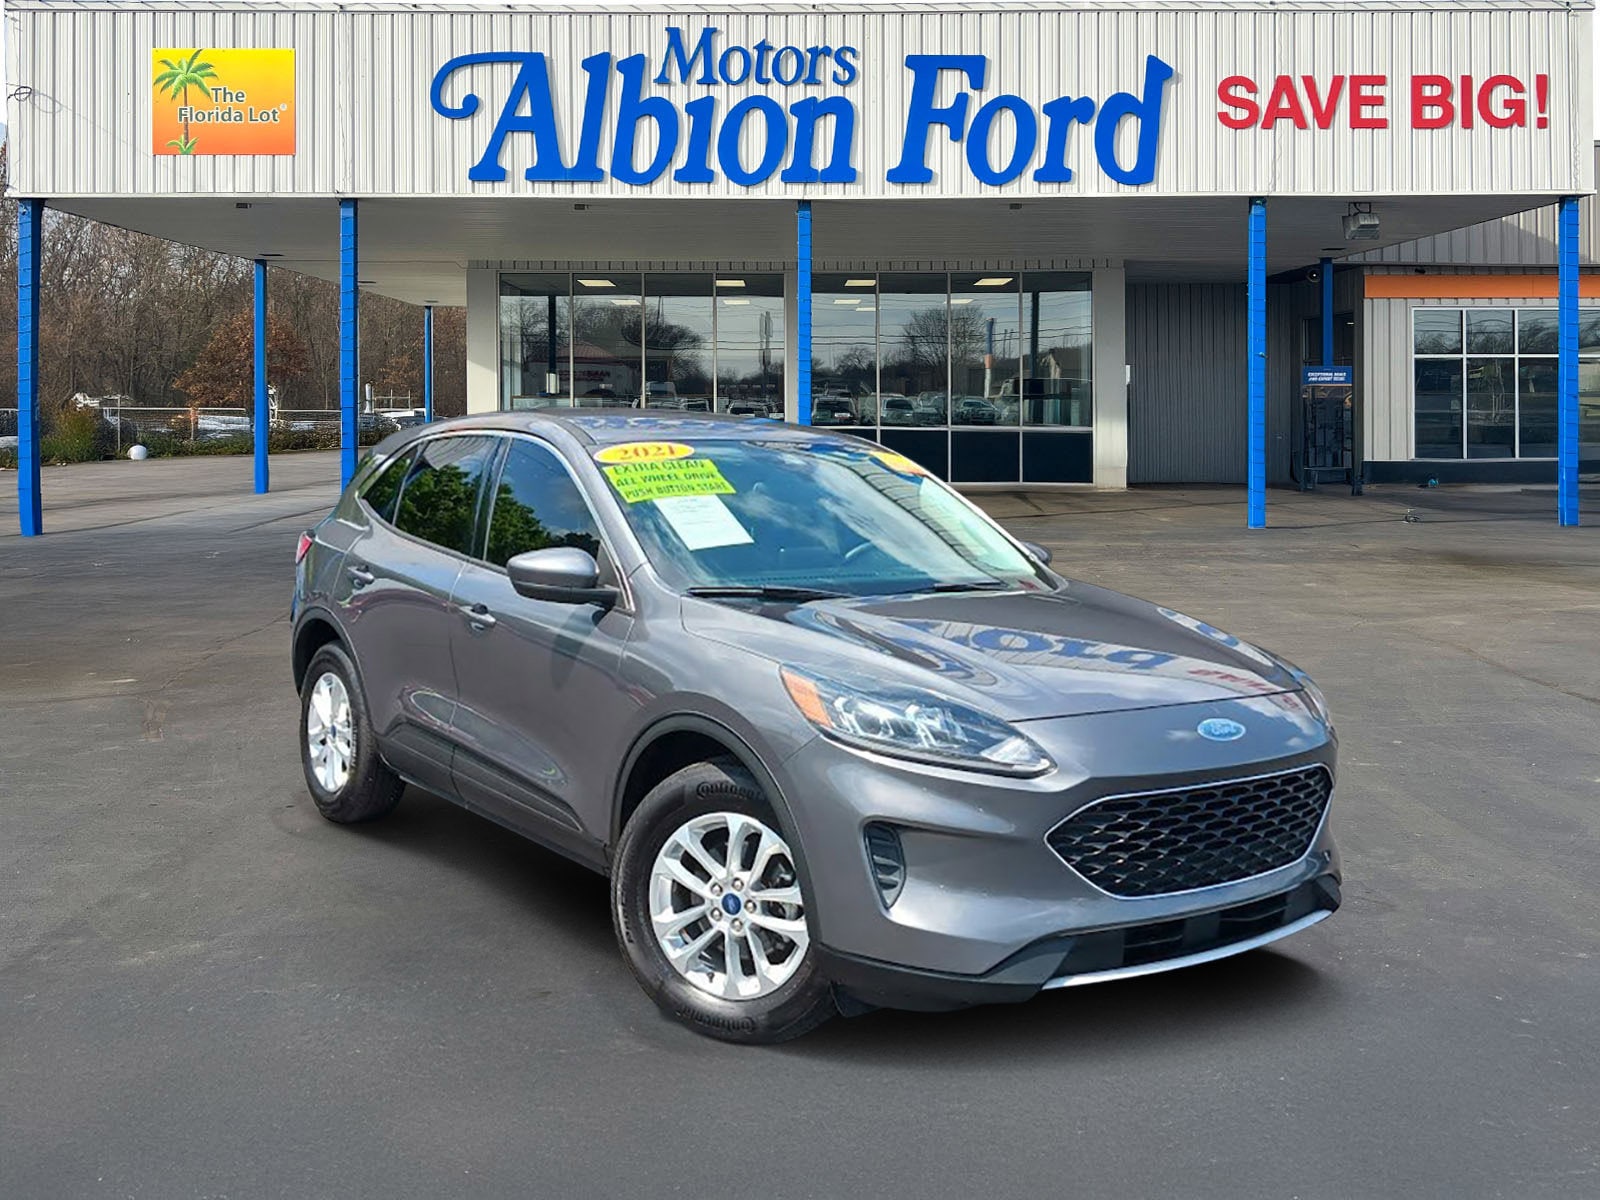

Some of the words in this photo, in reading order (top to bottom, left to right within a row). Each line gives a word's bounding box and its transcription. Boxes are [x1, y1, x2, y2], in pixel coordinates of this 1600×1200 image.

[654, 27, 856, 87] Motors
[210, 86, 246, 103] The
[1218, 75, 1388, 130] SAVE
[1411, 74, 1548, 130] BIG!
[178, 106, 244, 123] Florida
[248, 107, 280, 122] Lot
[430, 52, 856, 187] Albion
[887, 55, 1174, 186] Ford
[619, 445, 676, 460] 2021
[613, 461, 660, 476] EXTRA
[661, 459, 705, 472] CLEAN
[616, 478, 638, 488] ALL
[640, 473, 681, 483] WHEEL
[683, 471, 719, 482] DRIVE
[625, 486, 656, 499] PUSH
[656, 484, 696, 496] BUTTON
[697, 481, 729, 493] START
